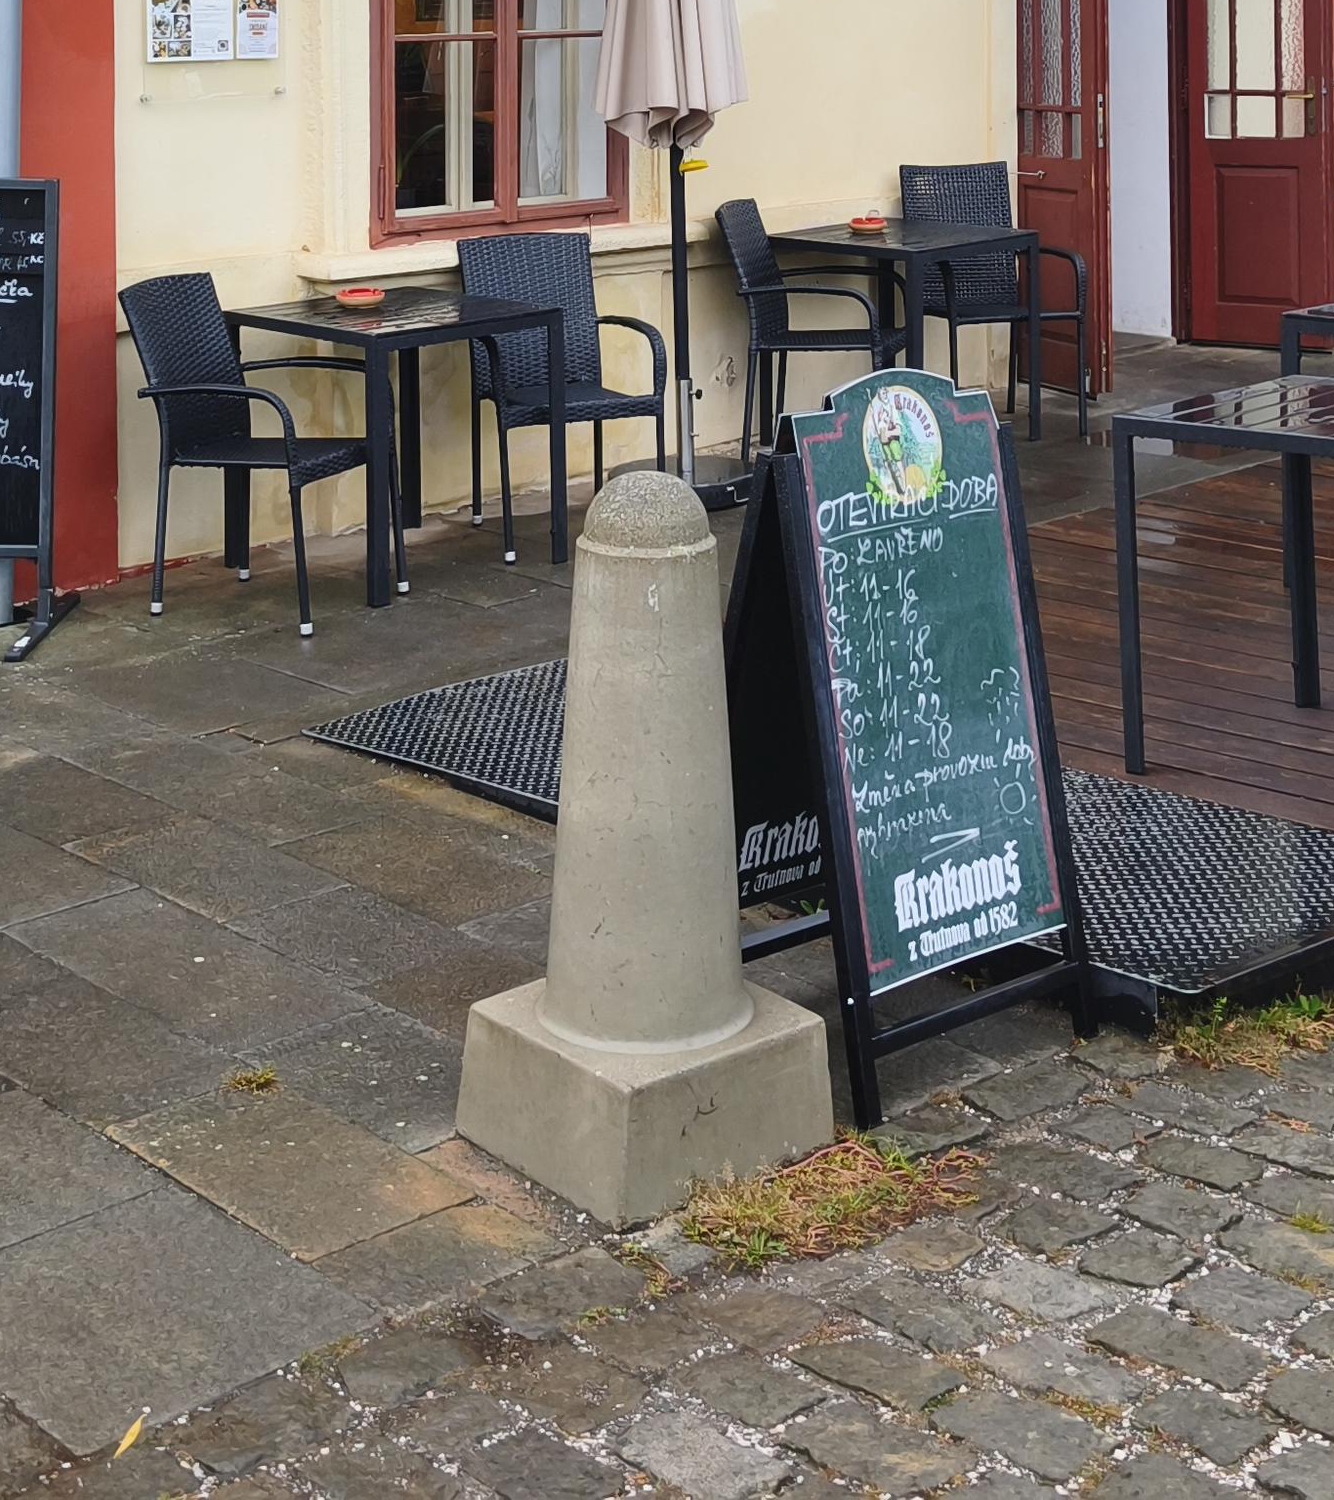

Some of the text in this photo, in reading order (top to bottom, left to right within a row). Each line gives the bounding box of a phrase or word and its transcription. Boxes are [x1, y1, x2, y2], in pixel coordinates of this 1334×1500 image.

[941, 473, 999, 511] DOBA
[741, 880, 750, 897] z
[753, 863, 805, 893] Trutnova
[894, 839, 1022, 933] Krakonoš
[908, 900, 1019, 962] z Trutnova od 1582
